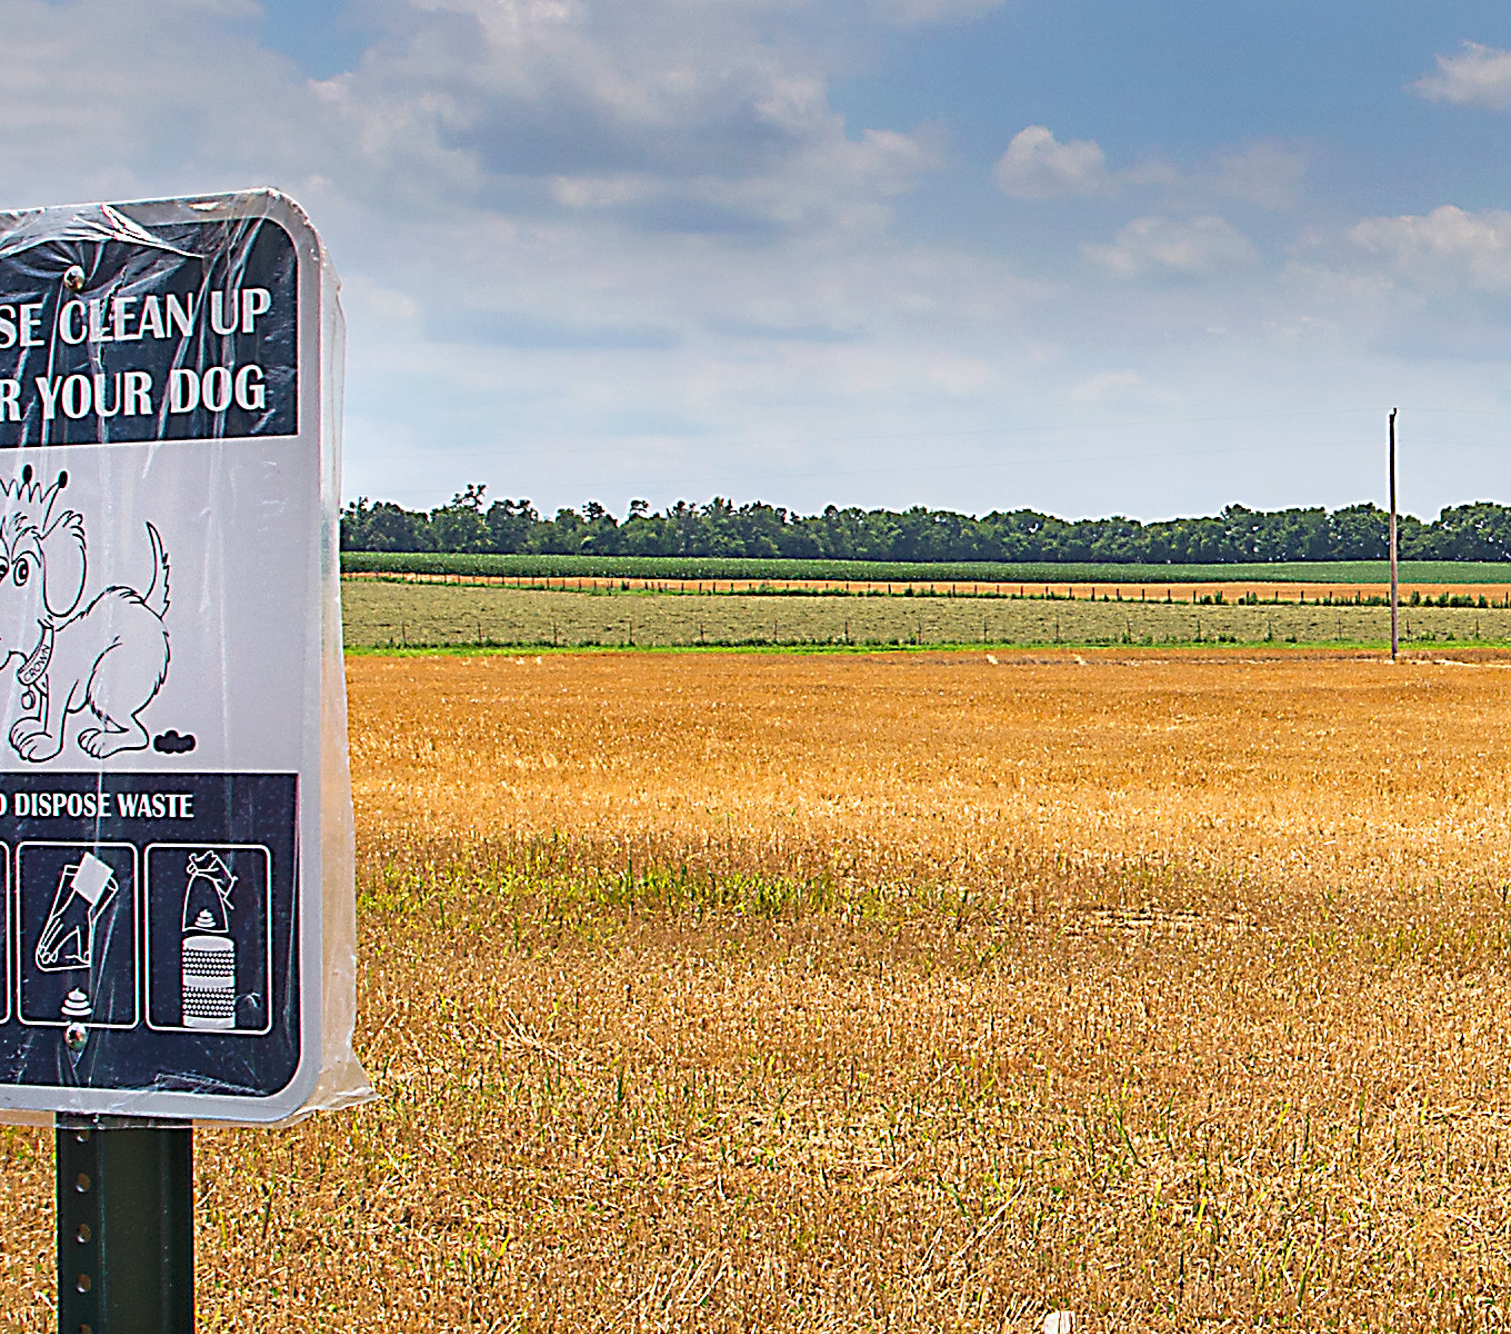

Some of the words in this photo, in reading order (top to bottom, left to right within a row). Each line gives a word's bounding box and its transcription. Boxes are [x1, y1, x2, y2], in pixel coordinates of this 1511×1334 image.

[58, 292, 193, 344] CLEAN
[211, 287, 272, 335] UP
[35, 372, 154, 421] YOUR
[170, 365, 266, 413] DOG
[23, 644, 50, 682] CROWN
[14, 793, 111, 817] DISPOSE
[117, 794, 194, 818] WASTE
